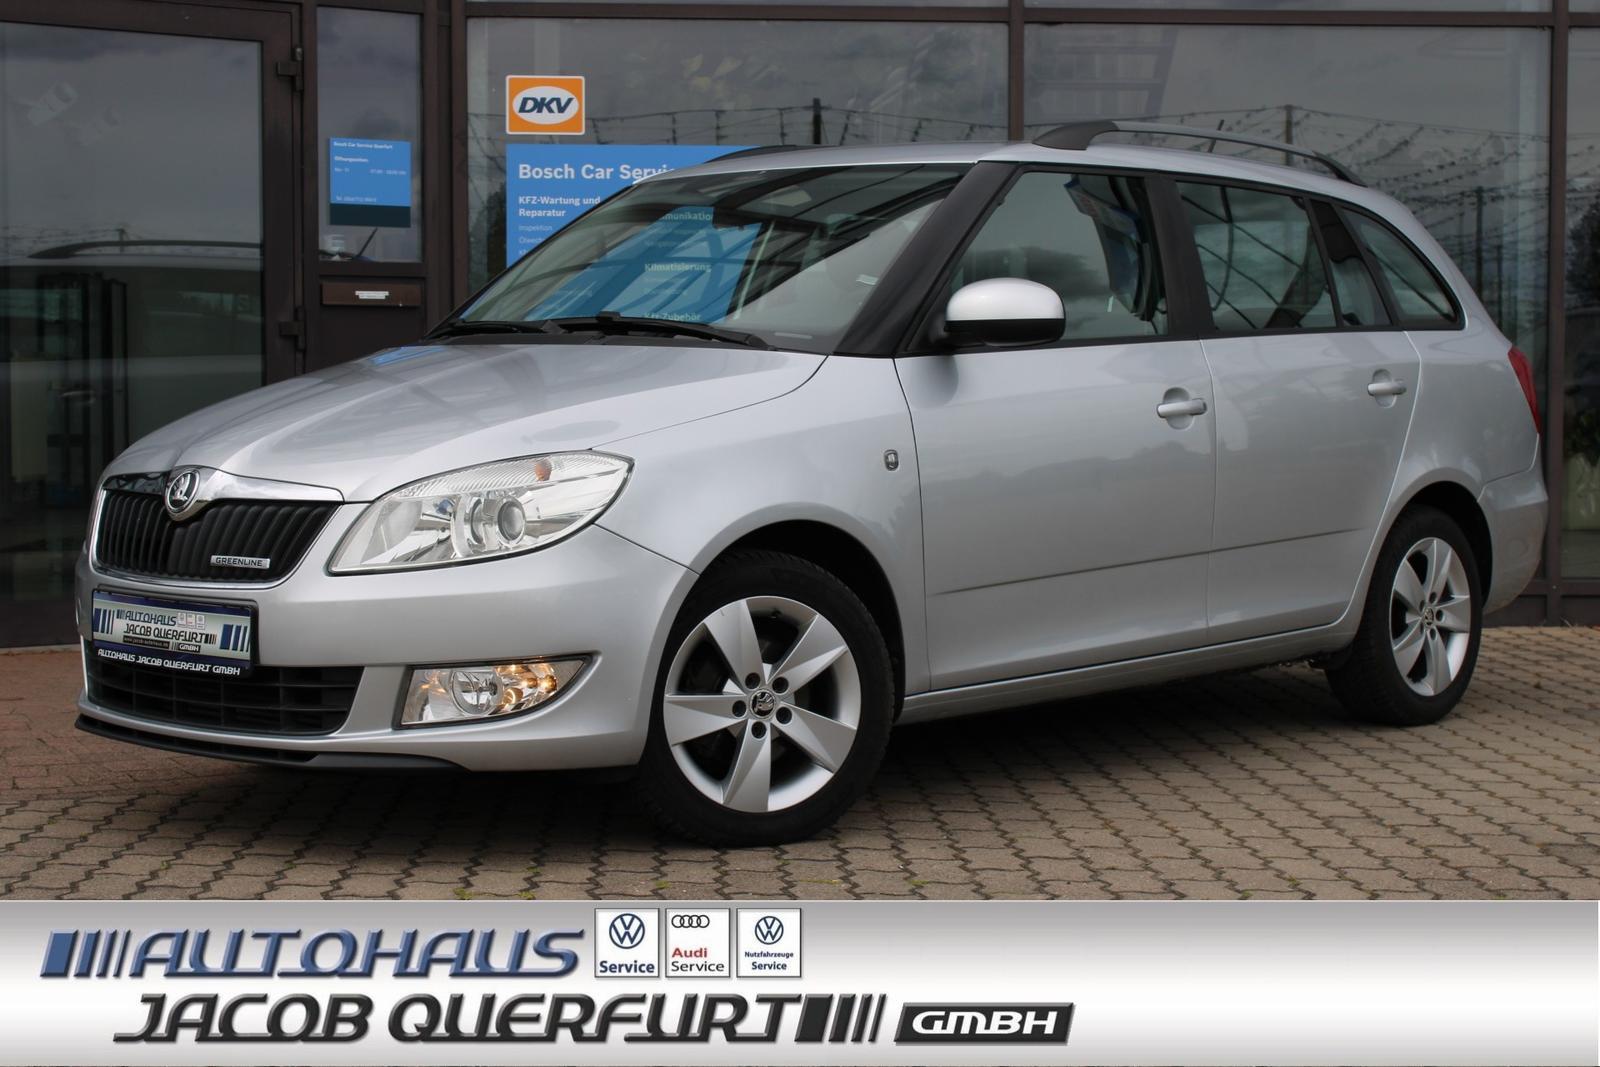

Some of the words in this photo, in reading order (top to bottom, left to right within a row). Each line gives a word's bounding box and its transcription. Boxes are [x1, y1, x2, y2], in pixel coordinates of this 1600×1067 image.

[518, 97, 575, 114] DKV
[519, 164, 575, 180] Bosch
[581, 164, 614, 180] Car
[519, 196, 580, 206] KFZ-Wartung
[583, 196, 601, 204] und
[519, 208, 566, 218] Reparatur
[644, 263, 712, 273] Klimatisierung
[215, 557, 263, 567] GREENLINE
[125, 610, 177, 626] AUTOHAUS
[124, 623, 152, 637] JACOB
[153, 627, 205, 643] QUERFURT
[98, 648, 136, 662] AUTOHAUS
[136, 655, 162, 667] JACOB
[163, 659, 211, 672] QUERFURT
[212, 665, 241, 675] GMBH
